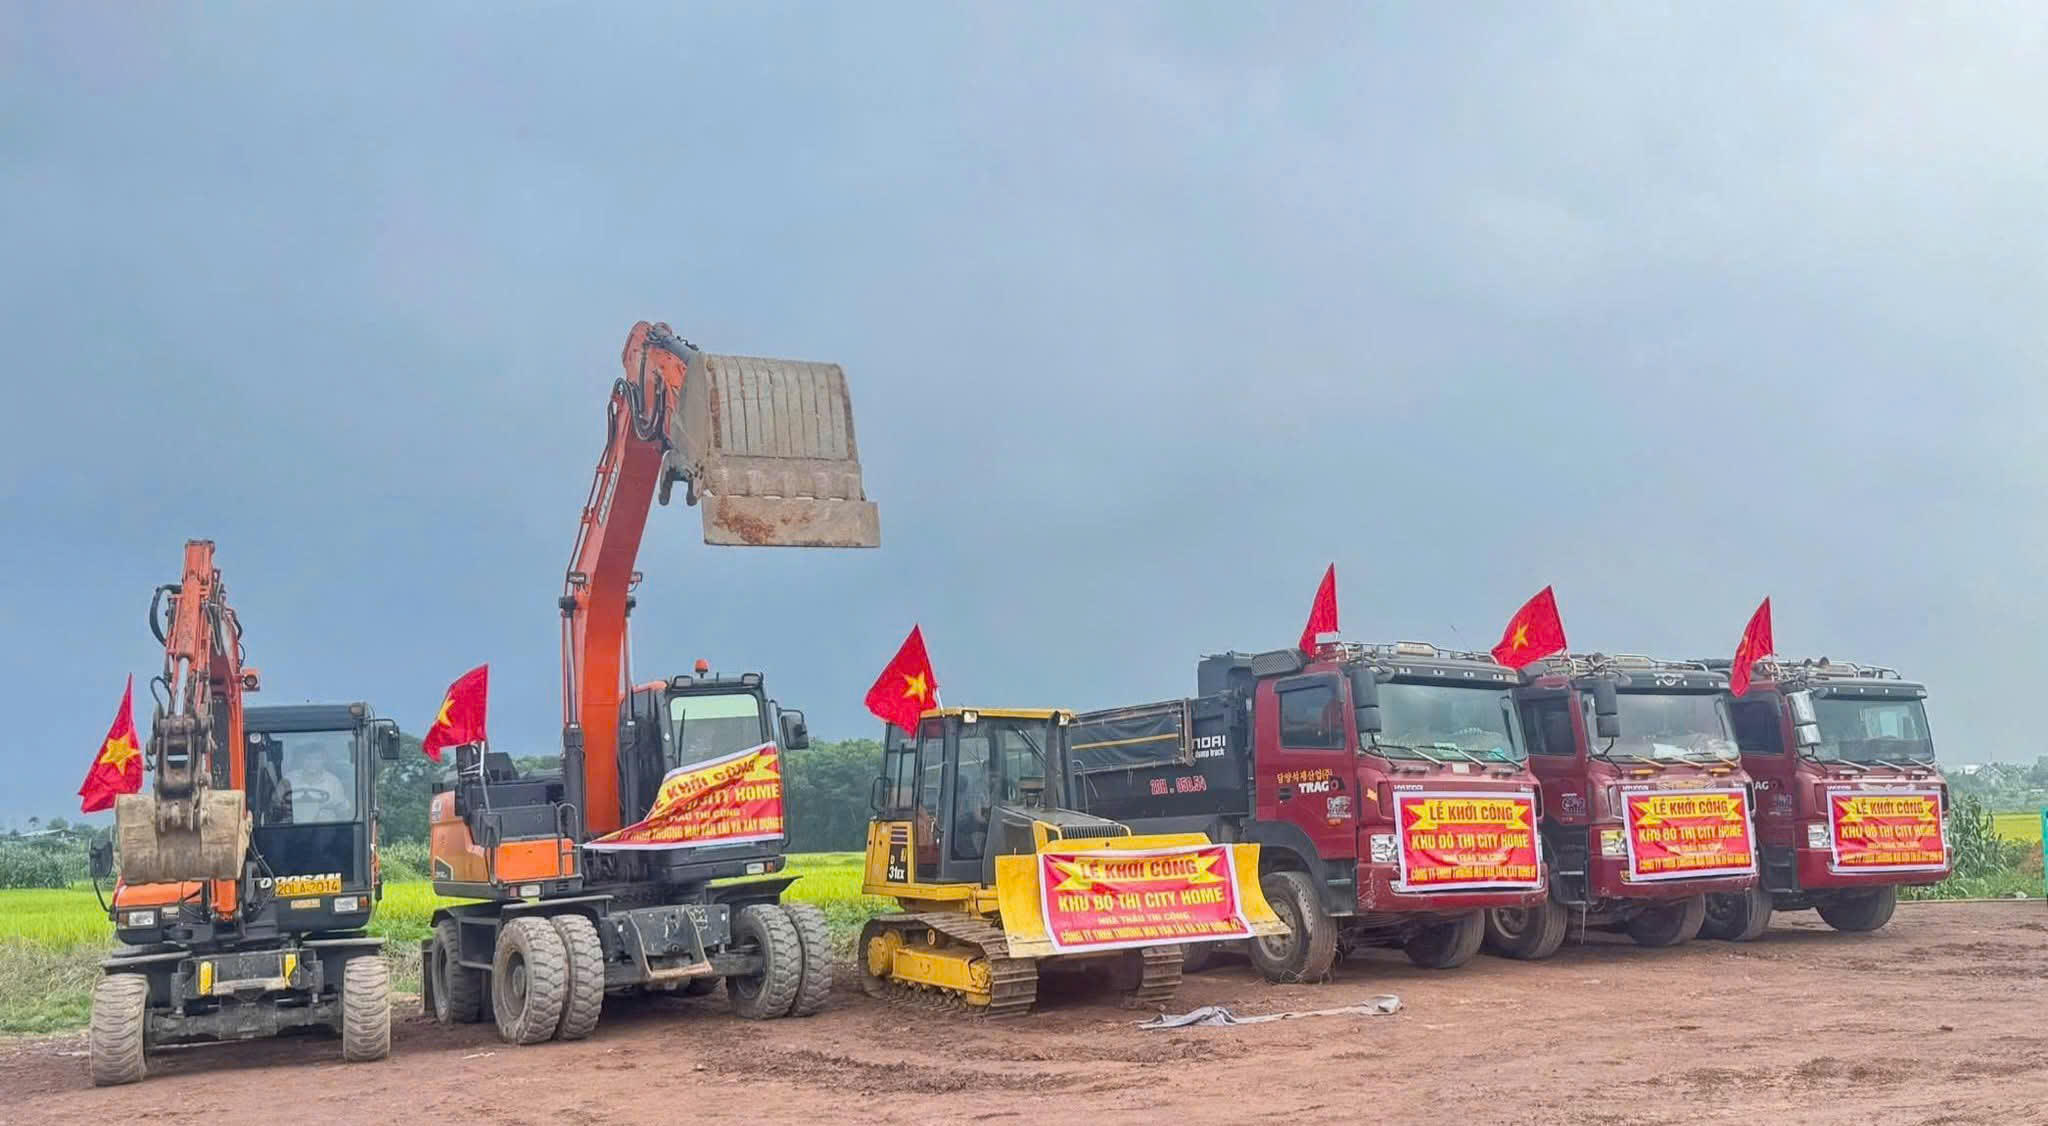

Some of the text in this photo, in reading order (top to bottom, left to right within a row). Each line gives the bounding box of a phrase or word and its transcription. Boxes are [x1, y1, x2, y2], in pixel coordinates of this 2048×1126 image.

[736, 783, 780, 802] HOME
[1481, 802, 1513, 821] CÔNG
[1699, 797, 1728, 814] CÔNG
[1411, 833, 1436, 850] KHU
[1477, 832, 1499, 849] CITY
[1150, 857, 1198, 879] CÔNG
[1058, 894, 1090, 913] KHU
[1144, 890, 1177, 909] CITY
[1181, 887, 1225, 906] HOME
